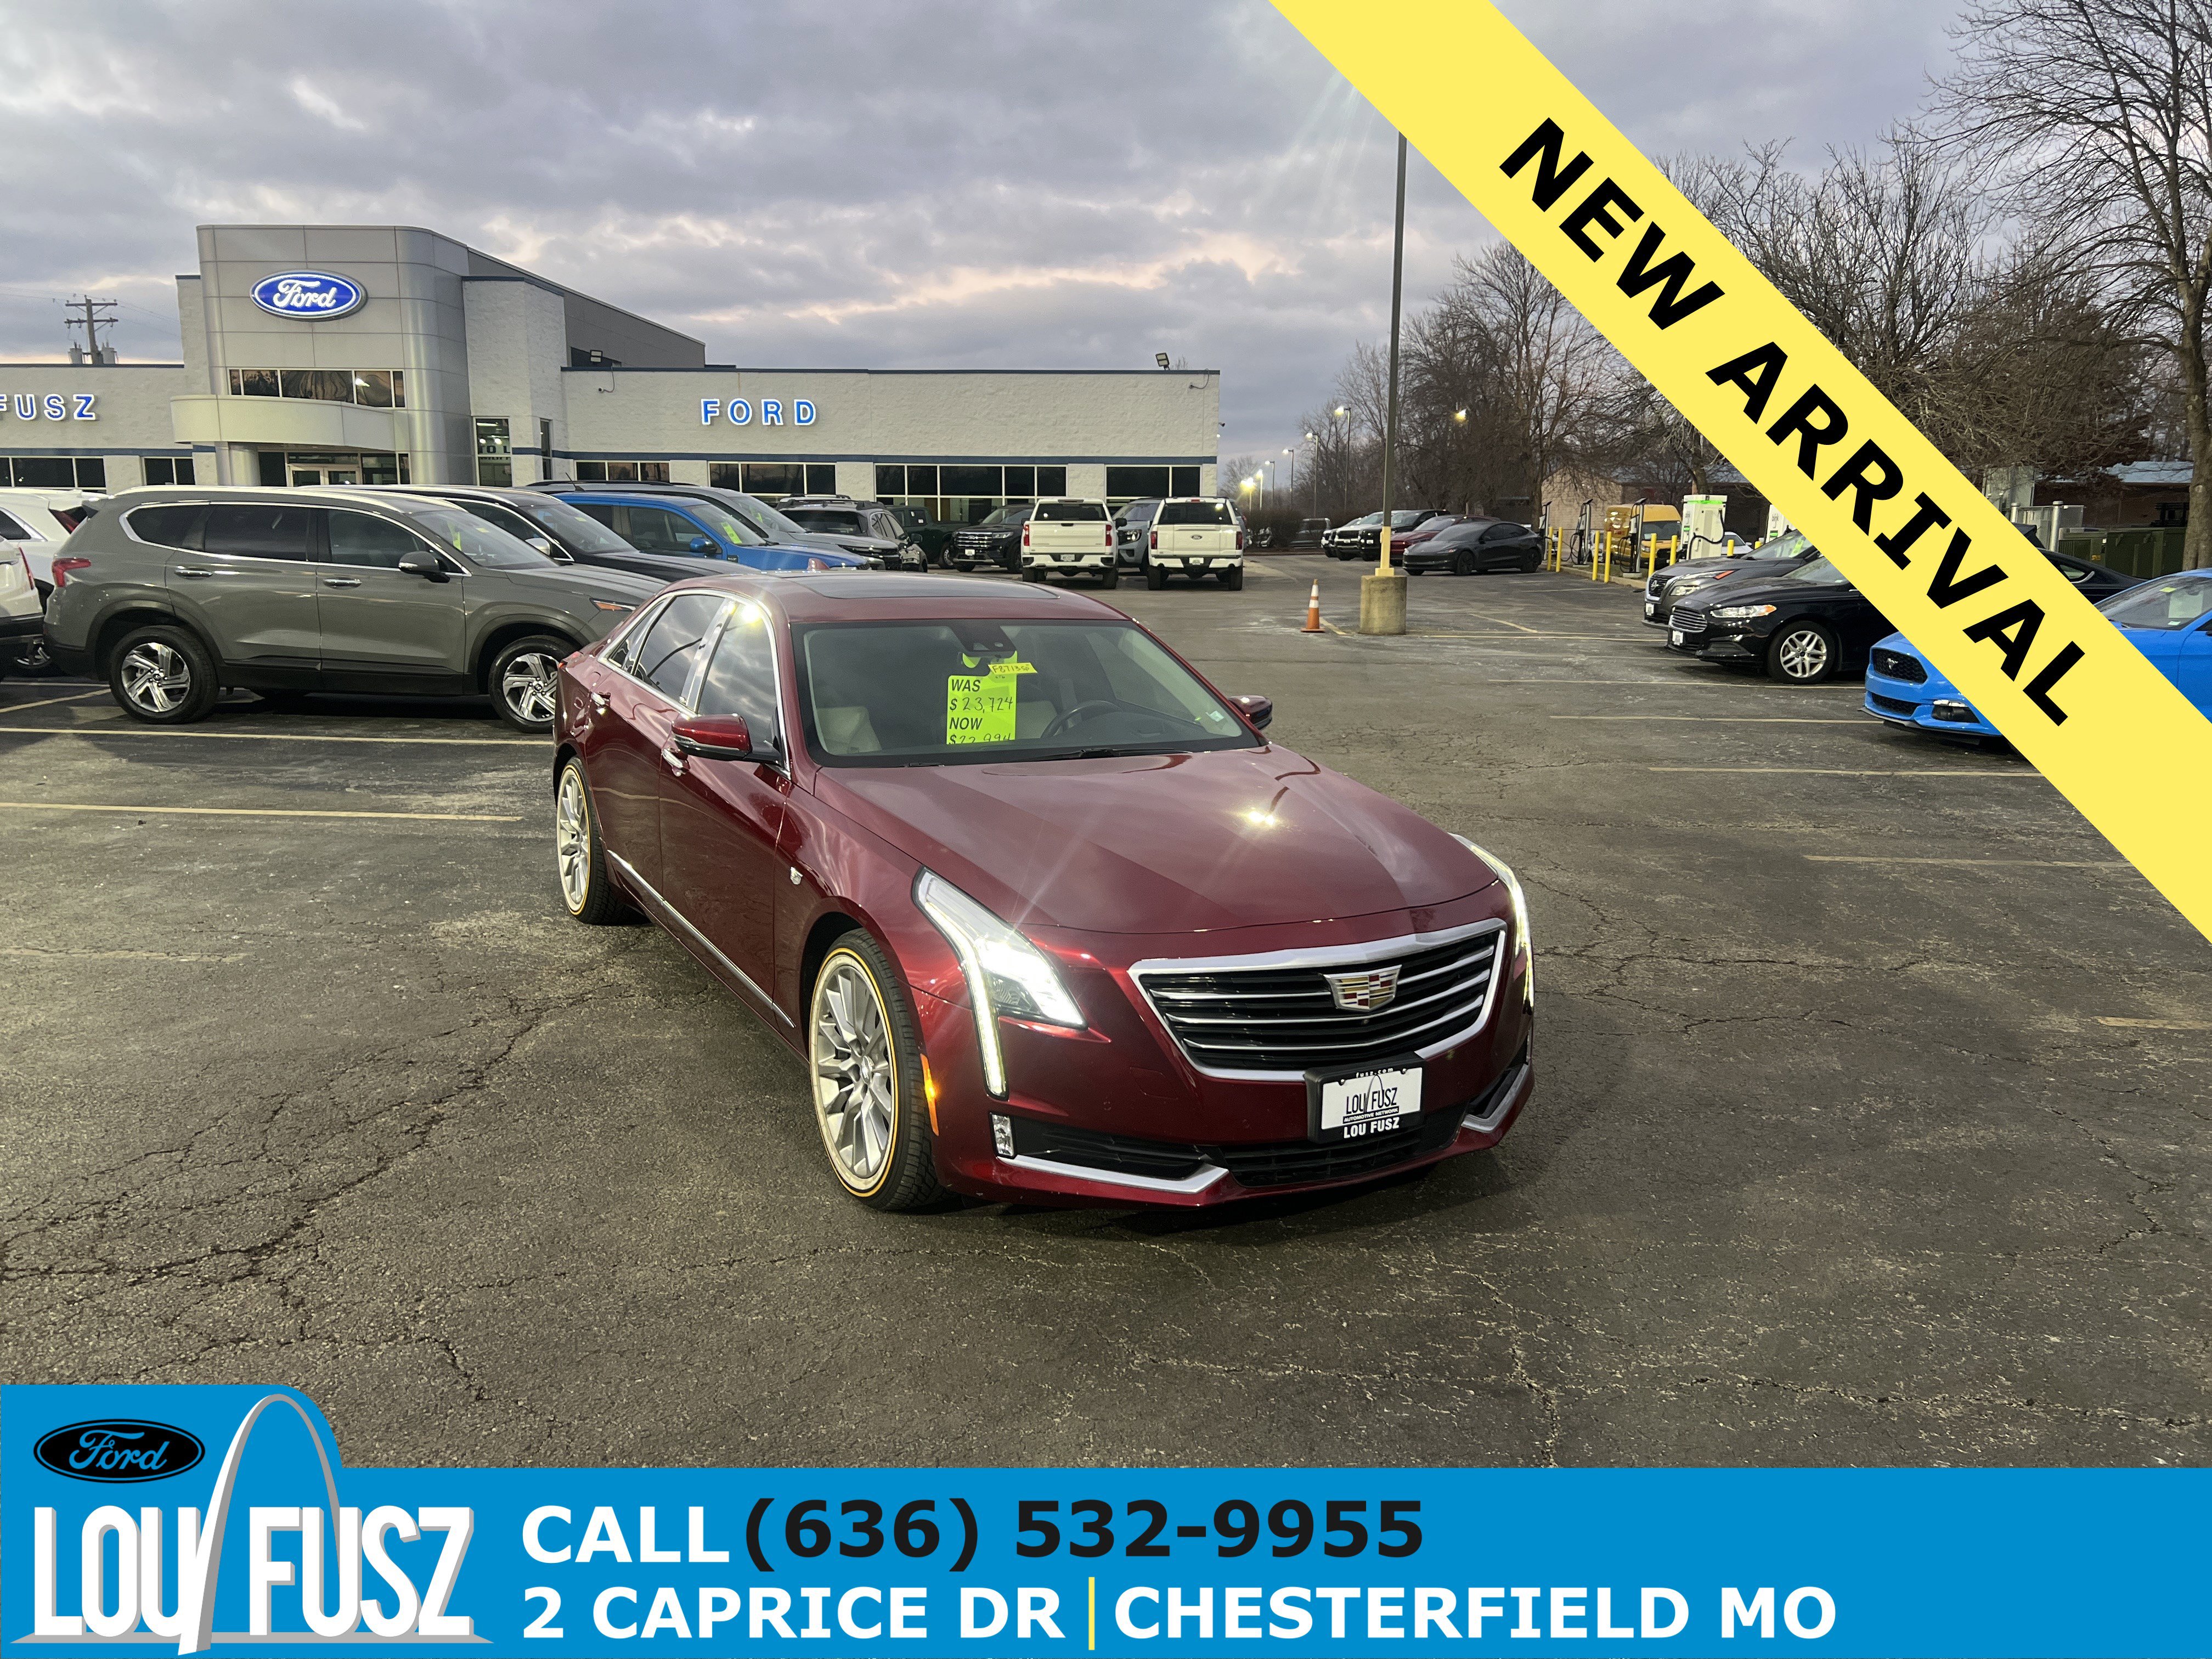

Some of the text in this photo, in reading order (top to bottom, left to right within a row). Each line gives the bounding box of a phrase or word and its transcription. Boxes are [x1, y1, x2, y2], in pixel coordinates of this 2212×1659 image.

[273, 279, 337, 308] Ford
[701, 398, 816, 426] FORD
[951, 679, 981, 692] WAS
[949, 717, 983, 730] NOW
[1346, 1087, 1398, 1114] LOU FUSZ
[1344, 1108, 1398, 1122] AUTOMOTIVE NETWORK
[1344, 1116, 1400, 1138] LOU FUSZ
